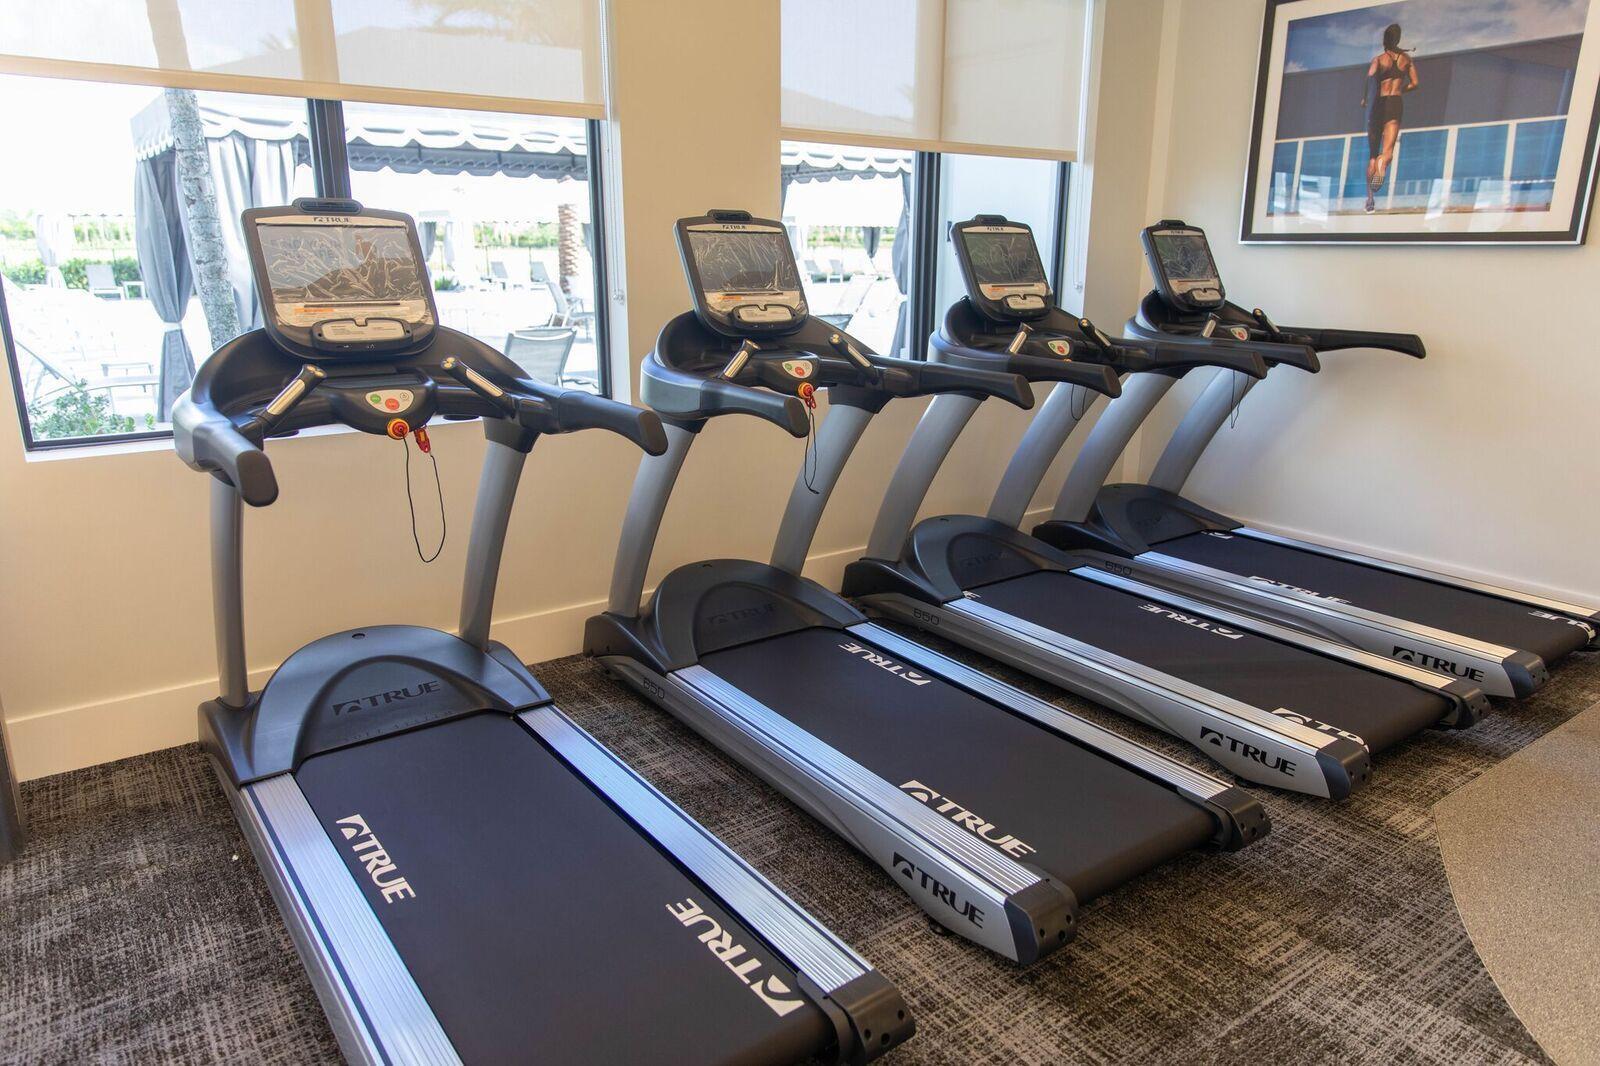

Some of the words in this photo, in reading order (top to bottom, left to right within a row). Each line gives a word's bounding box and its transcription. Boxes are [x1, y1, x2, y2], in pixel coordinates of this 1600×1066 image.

[1138, 604, 1210, 631] TRUE
[838, 642, 903, 675] TRUE
[1417, 652, 1485, 683] TRUE
[362, 680, 441, 707] TRUE
[1226, 735, 1297, 777] TRUE
[936, 797, 1037, 858] TRUE
[352, 833, 416, 904] TRUE
[916, 867, 985, 929] TRUE
[665, 898, 762, 985] TRUE
